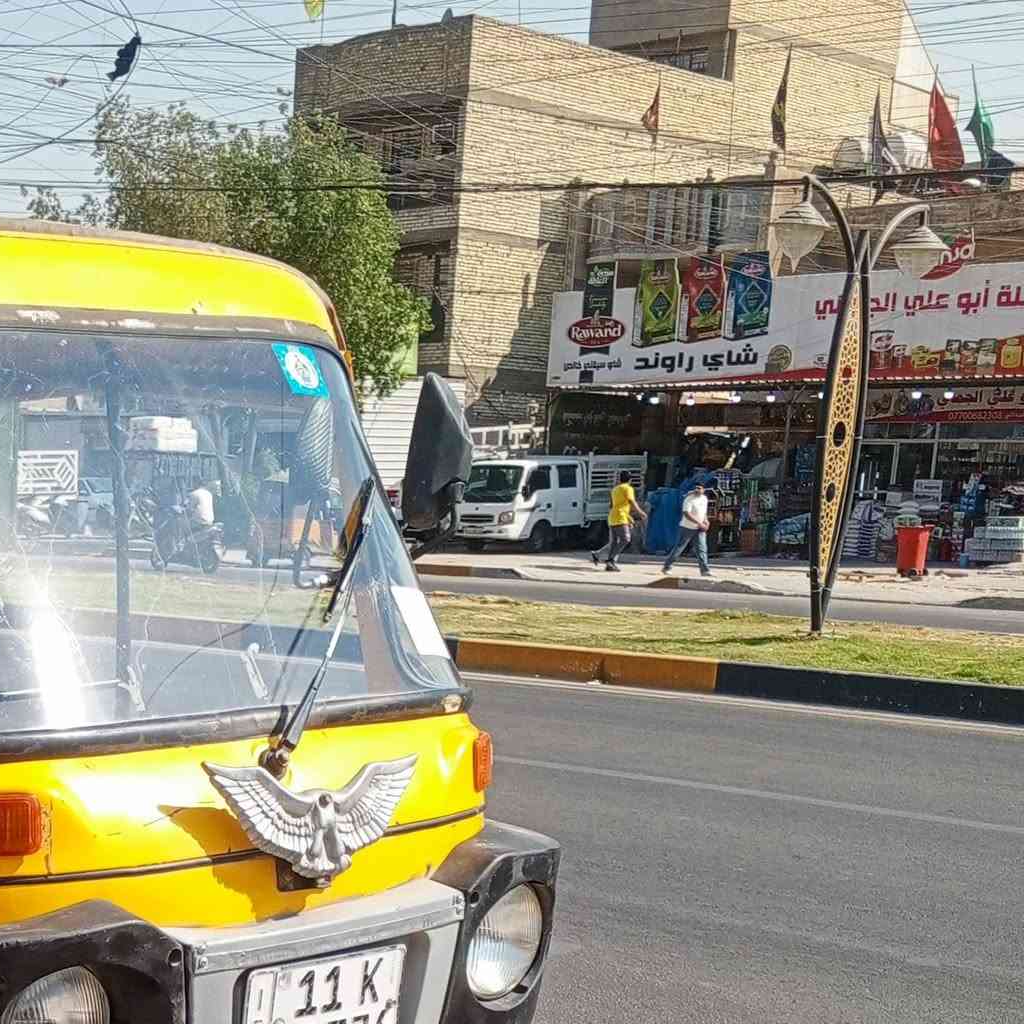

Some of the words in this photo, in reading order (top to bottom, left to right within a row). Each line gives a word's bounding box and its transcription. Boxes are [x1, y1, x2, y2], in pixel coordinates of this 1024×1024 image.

[903, 290, 951, 316] علي
[957, 280, 990, 315] أبو
[571, 324, 622, 341] Rawand
[634, 352, 694, 373] راوند
[702, 344, 758, 371] شاي
[294, 965, 343, 1018] 11
[360, 957, 384, 1005] K
